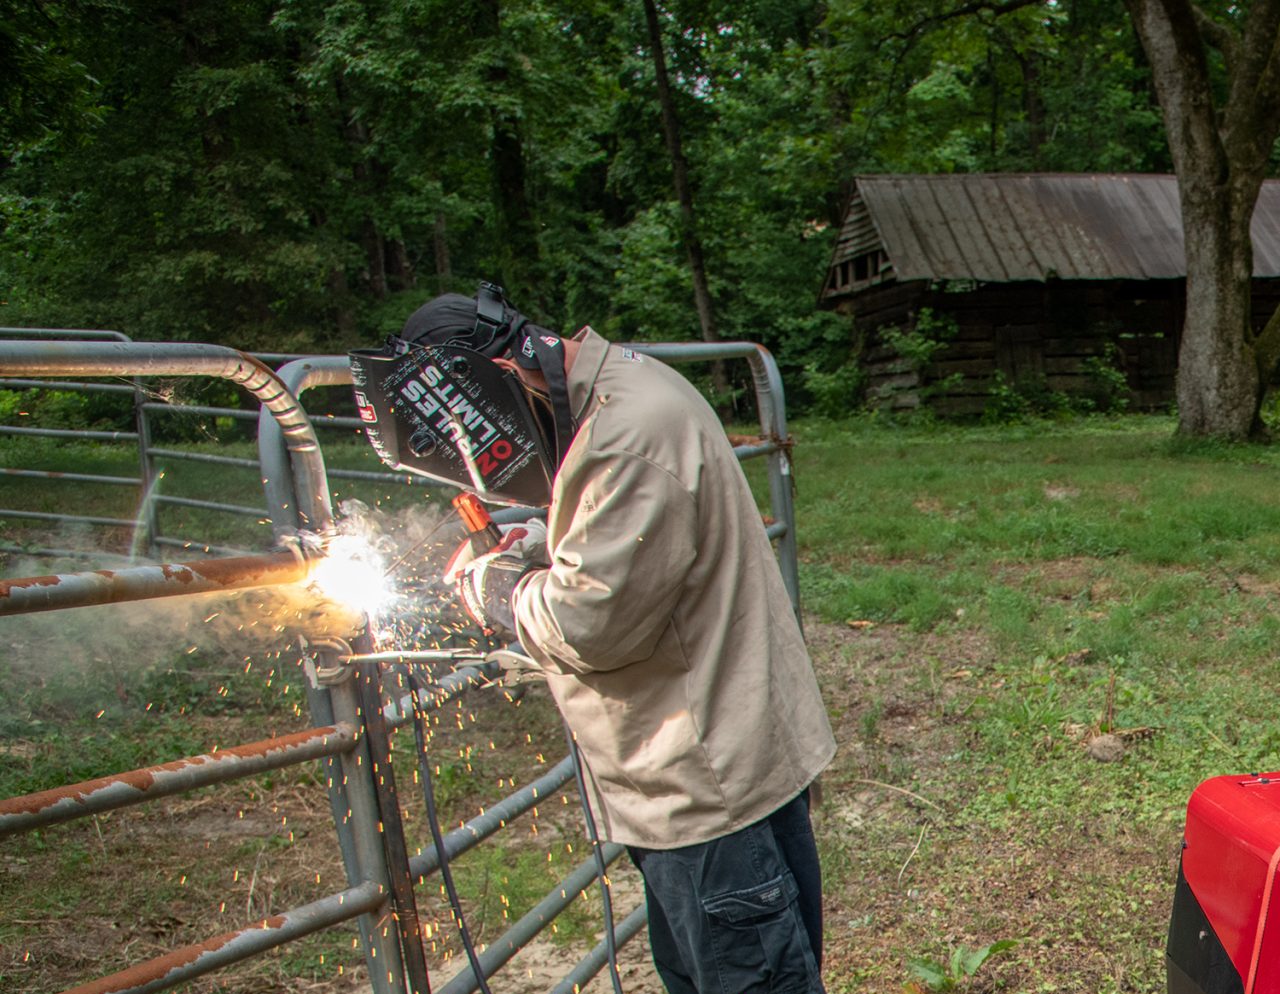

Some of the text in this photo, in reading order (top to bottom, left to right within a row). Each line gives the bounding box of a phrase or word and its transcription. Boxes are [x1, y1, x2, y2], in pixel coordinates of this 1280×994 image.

[401, 379, 480, 458] RULES
[419, 365, 497, 443] LIMITS
[474, 440, 513, 478] NO
